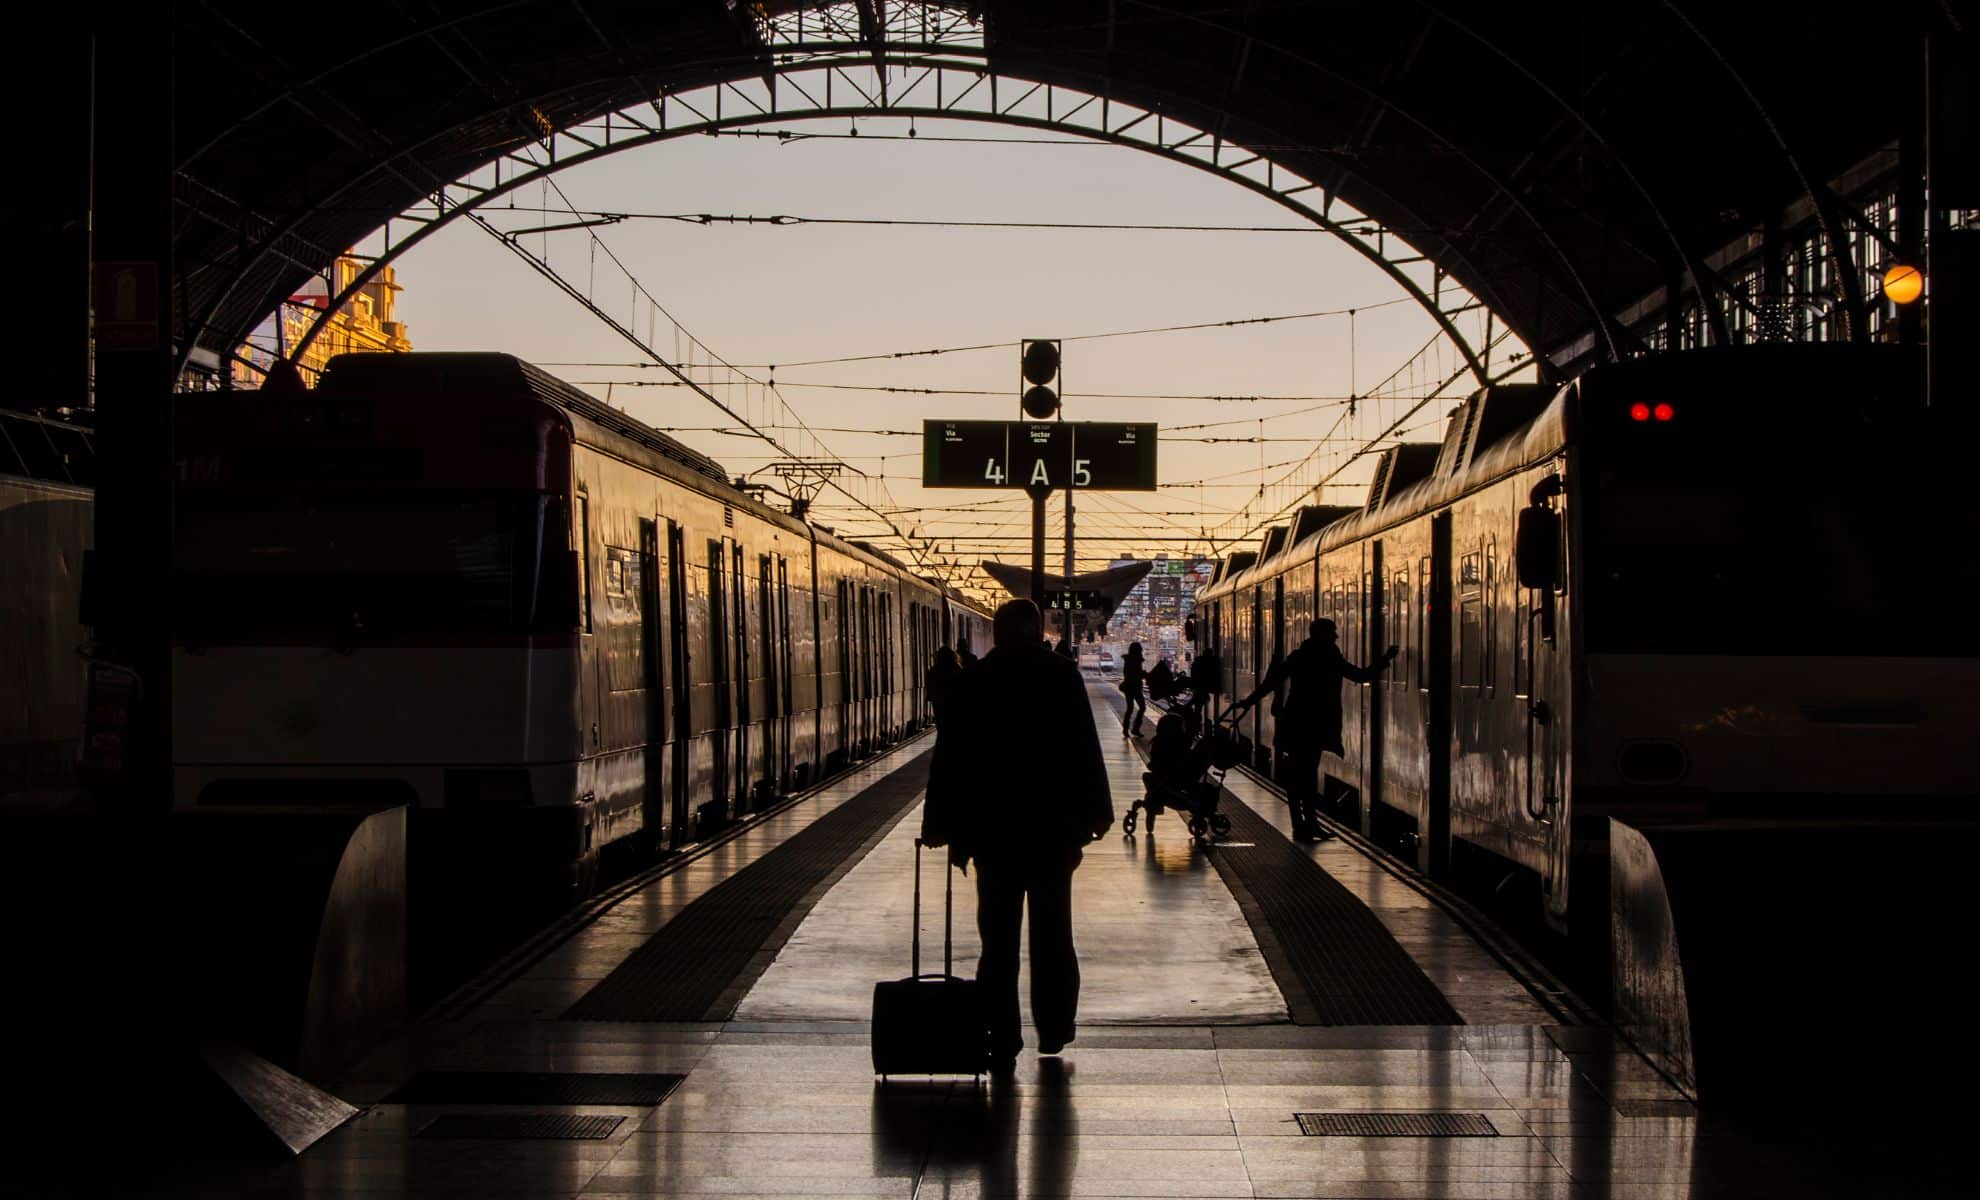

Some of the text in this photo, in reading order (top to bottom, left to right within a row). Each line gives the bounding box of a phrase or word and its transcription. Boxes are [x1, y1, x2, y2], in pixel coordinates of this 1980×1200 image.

[985, 458, 1004, 485] 4
[1030, 458, 1049, 486] A
[1075, 459, 1091, 486] 5
[1051, 600, 1057, 609] 4
[1076, 600, 1082, 609] 5
